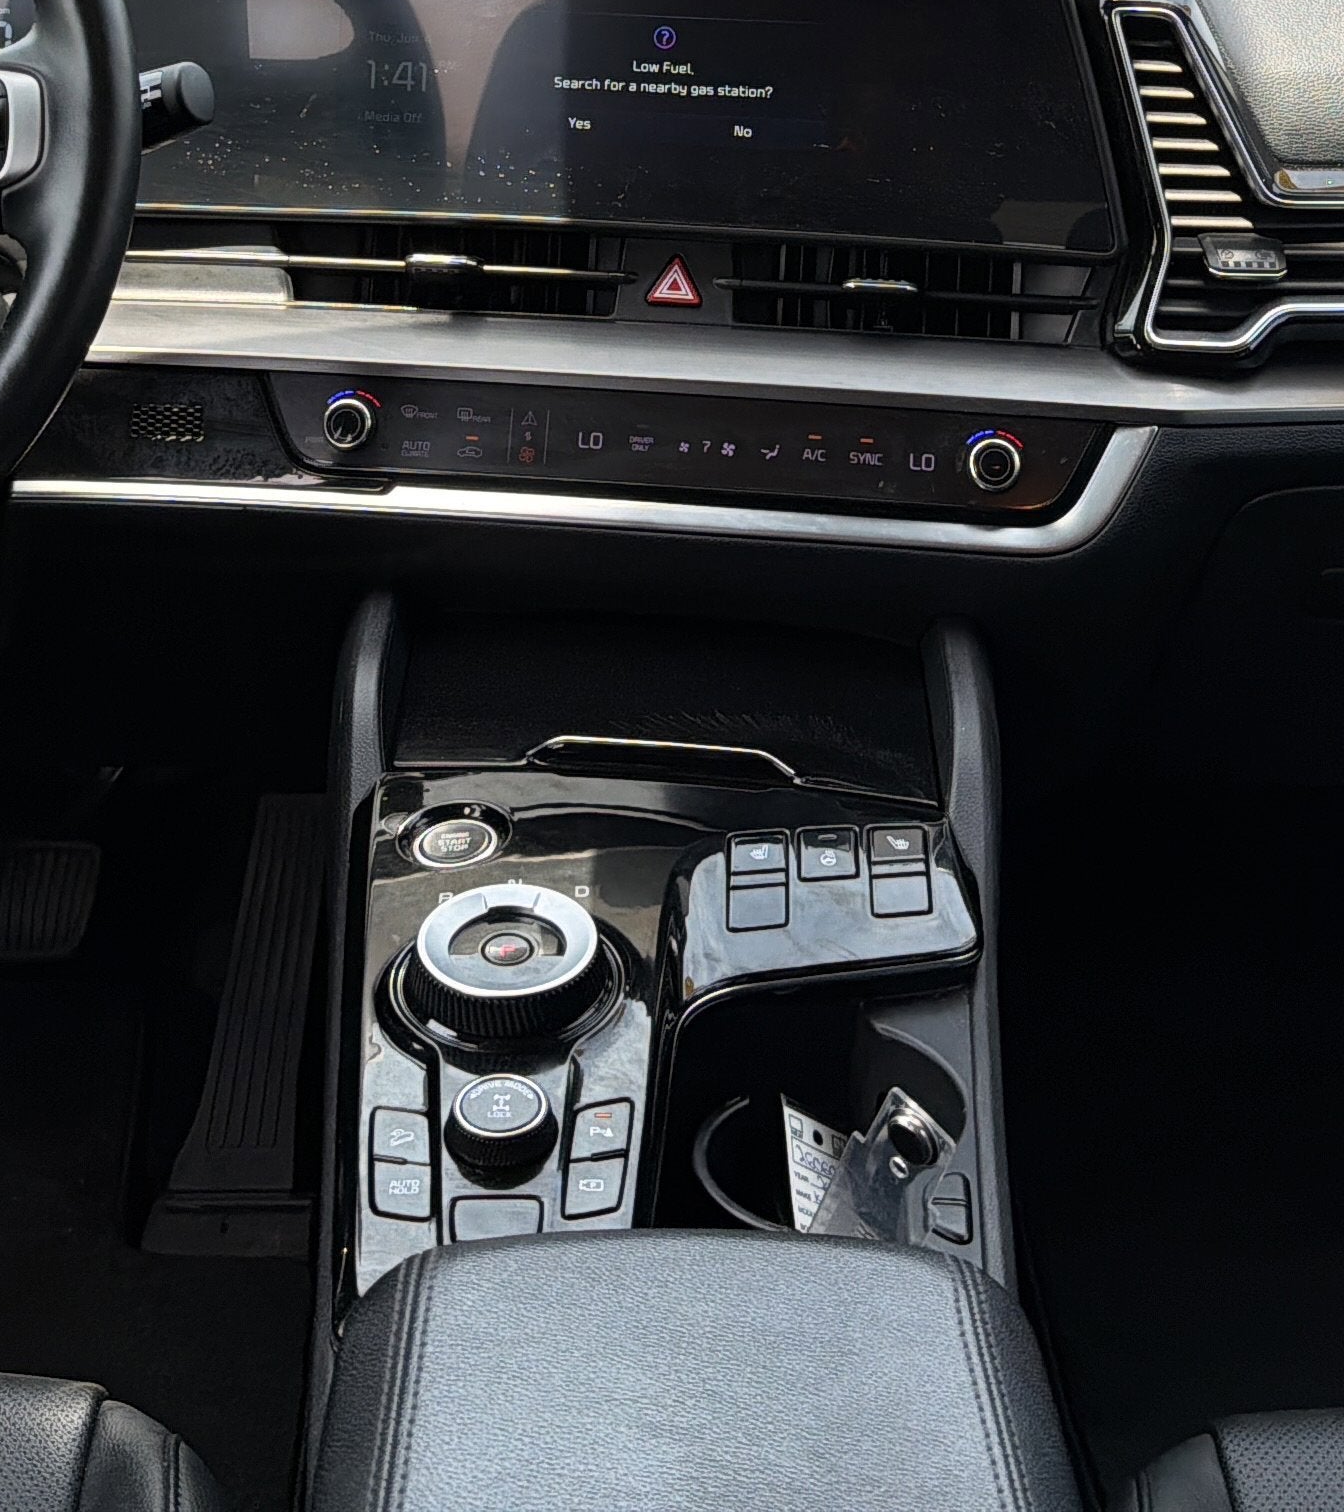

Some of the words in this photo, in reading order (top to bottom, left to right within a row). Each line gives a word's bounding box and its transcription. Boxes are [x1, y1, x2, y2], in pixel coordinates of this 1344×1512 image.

[632, 60, 660, 74] Low
[366, 59, 428, 92] 1:41
[553, 75, 602, 90] Search
[603, 78, 626, 92] for
[627, 81, 638, 93] a
[640, 80, 688, 96] nearby
[690, 85, 715, 97] gas
[716, 85, 774, 100] station?
[363, 109, 401, 124] Media
[567, 116, 592, 131] Yes
[733, 124, 753, 139] No
[401, 440, 431, 451] AUTO
[578, 431, 604, 450] LO
[702, 440, 712, 453] 7
[802, 448, 827, 463] A/C
[849, 451, 884, 467] SYNC
[909, 453, 936, 472] LO
[574, 885, 591, 898] D
[500, 943, 517, 958] P
[487, 1111, 513, 1119] LOCK
[388, 1186, 420, 1195] HOLD
[389, 1179, 421, 1188] AUTO
